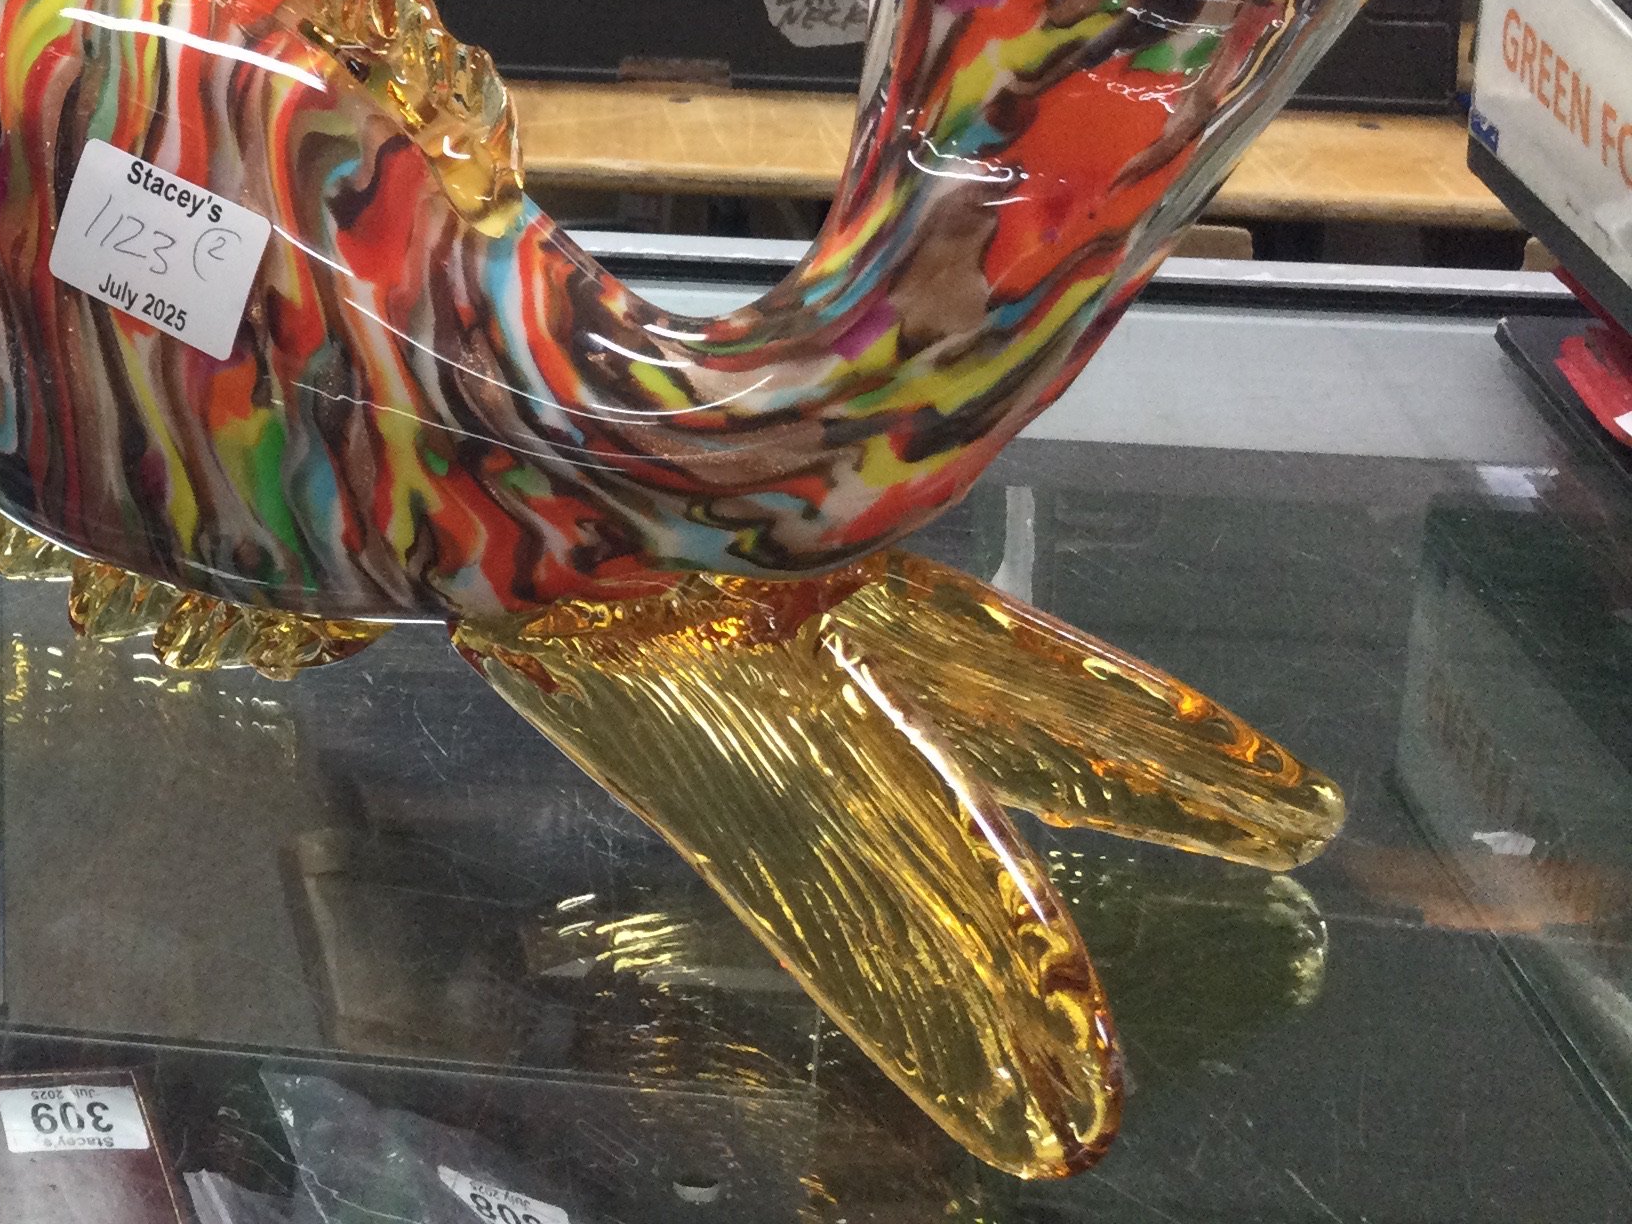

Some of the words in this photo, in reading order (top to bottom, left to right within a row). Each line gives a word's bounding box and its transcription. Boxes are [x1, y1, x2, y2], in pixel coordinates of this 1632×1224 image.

[1502, 7, 1592, 148] GREEN
[126, 160, 224, 224] Stacey's
[84, 194, 176, 275] 1123
[98, 273, 139, 311] July
[141, 292, 188, 332] 2025
[30, 1089, 63, 1101] 2025
[30, 1101, 115, 1135] 309
